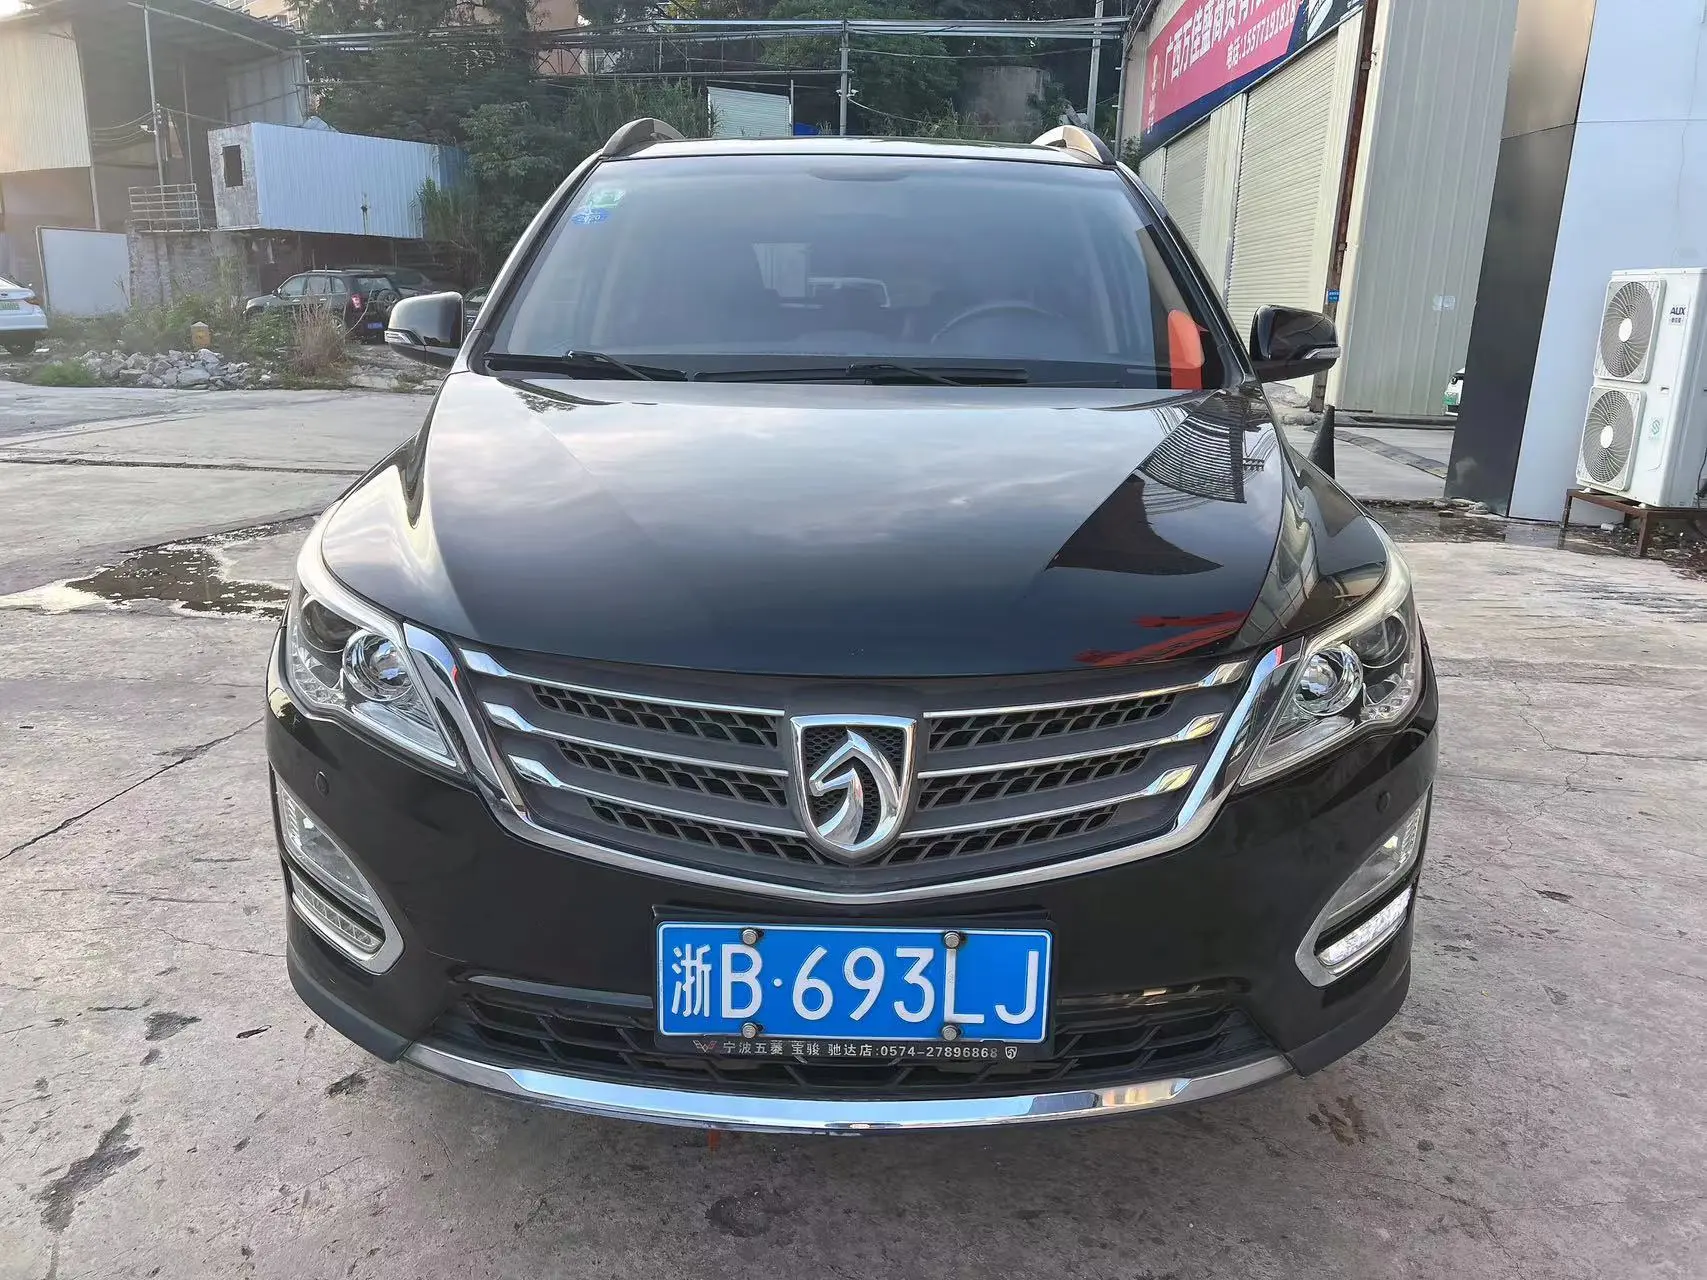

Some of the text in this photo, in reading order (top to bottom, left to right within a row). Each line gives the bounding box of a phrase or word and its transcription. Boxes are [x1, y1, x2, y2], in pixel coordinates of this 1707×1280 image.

[1670, 307, 1687, 316] AUX
[671, 943, 1040, 1025] 浙B·693LJ
[723, 1040, 783, 1056] 宁波五菱
[791, 1040, 821, 1057] 宝骏
